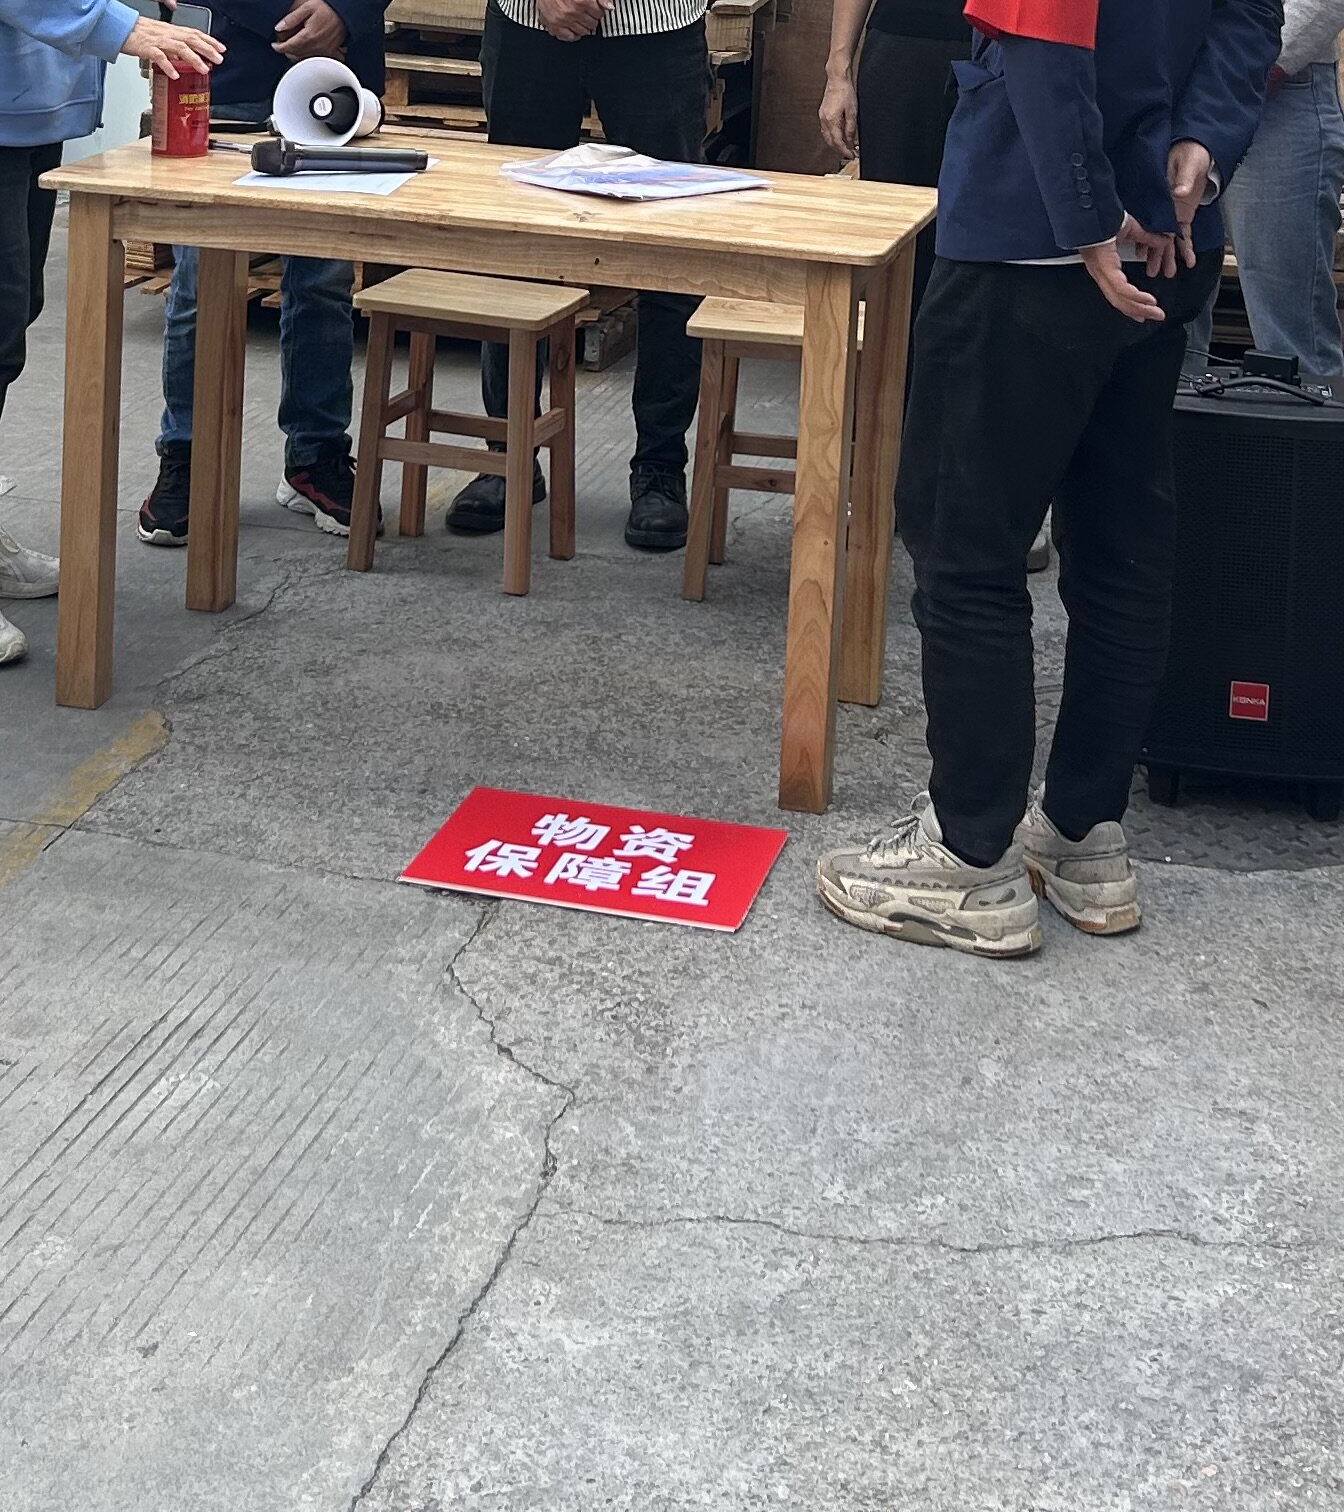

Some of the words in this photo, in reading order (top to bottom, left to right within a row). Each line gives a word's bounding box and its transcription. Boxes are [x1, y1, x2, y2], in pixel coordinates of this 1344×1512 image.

[1233, 696, 1266, 705] KONKA
[531, 813, 695, 863] 物资
[464, 839, 716, 906] 保障组
